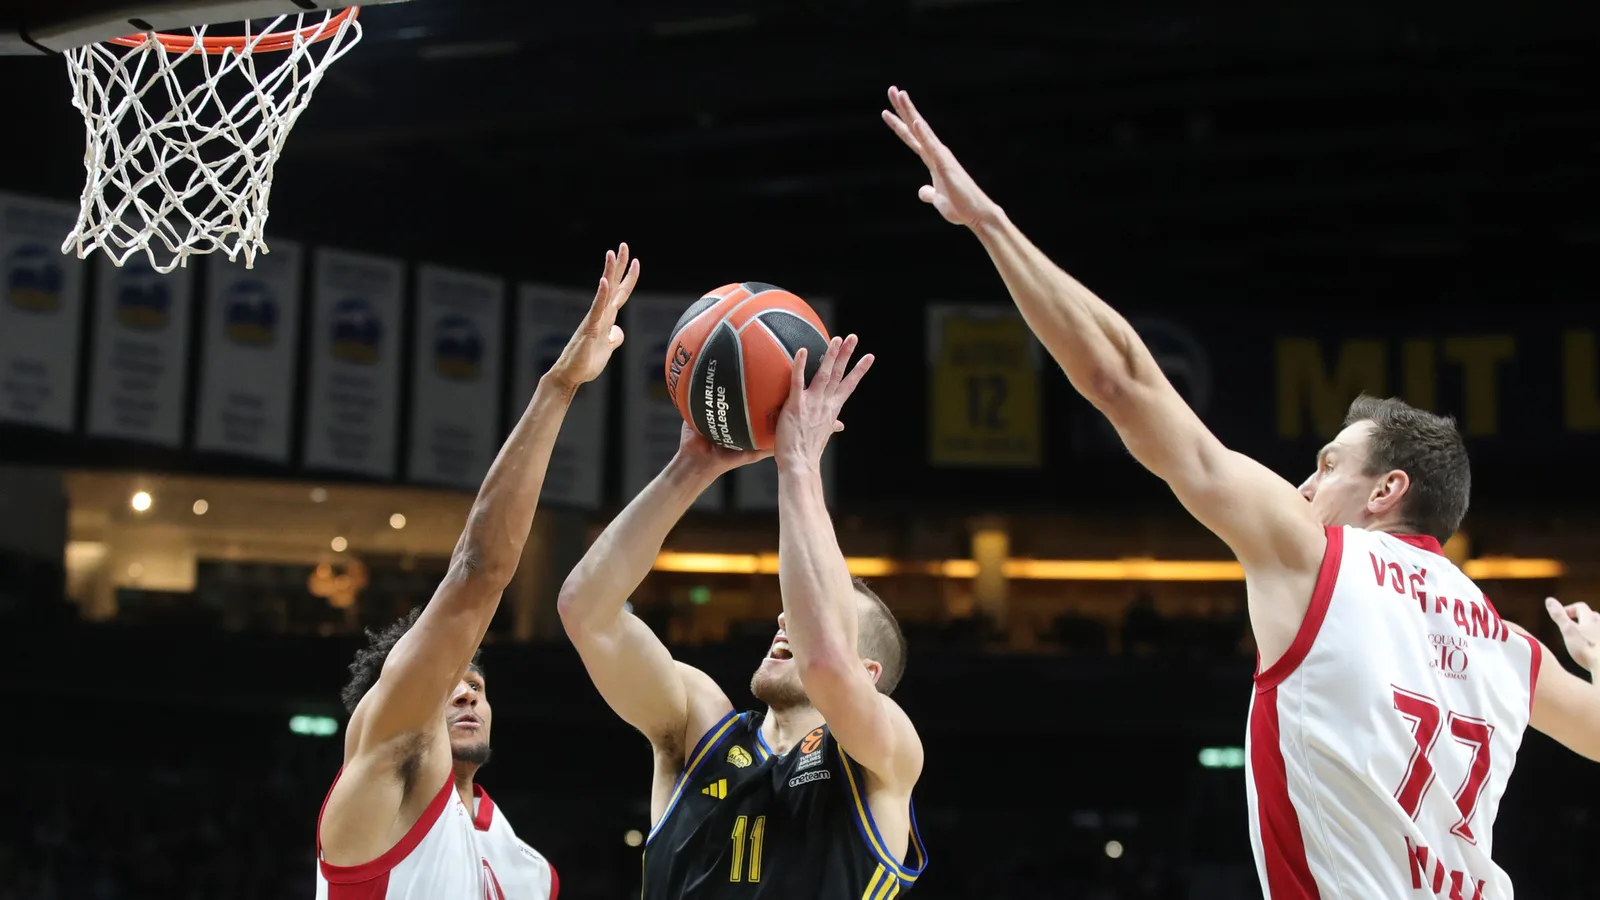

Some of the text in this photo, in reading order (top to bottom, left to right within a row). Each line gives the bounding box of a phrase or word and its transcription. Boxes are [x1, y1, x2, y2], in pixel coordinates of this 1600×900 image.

[705, 359, 720, 442] TURKISH AIRLINES
[716, 386, 734, 445] EuroLeague
[966, 375, 1009, 430] 12
[1275, 335, 1515, 437] MIT
[789, 769, 831, 788] oneteam
[1391, 683, 1495, 847] 77
[730, 815, 766, 883] 11
